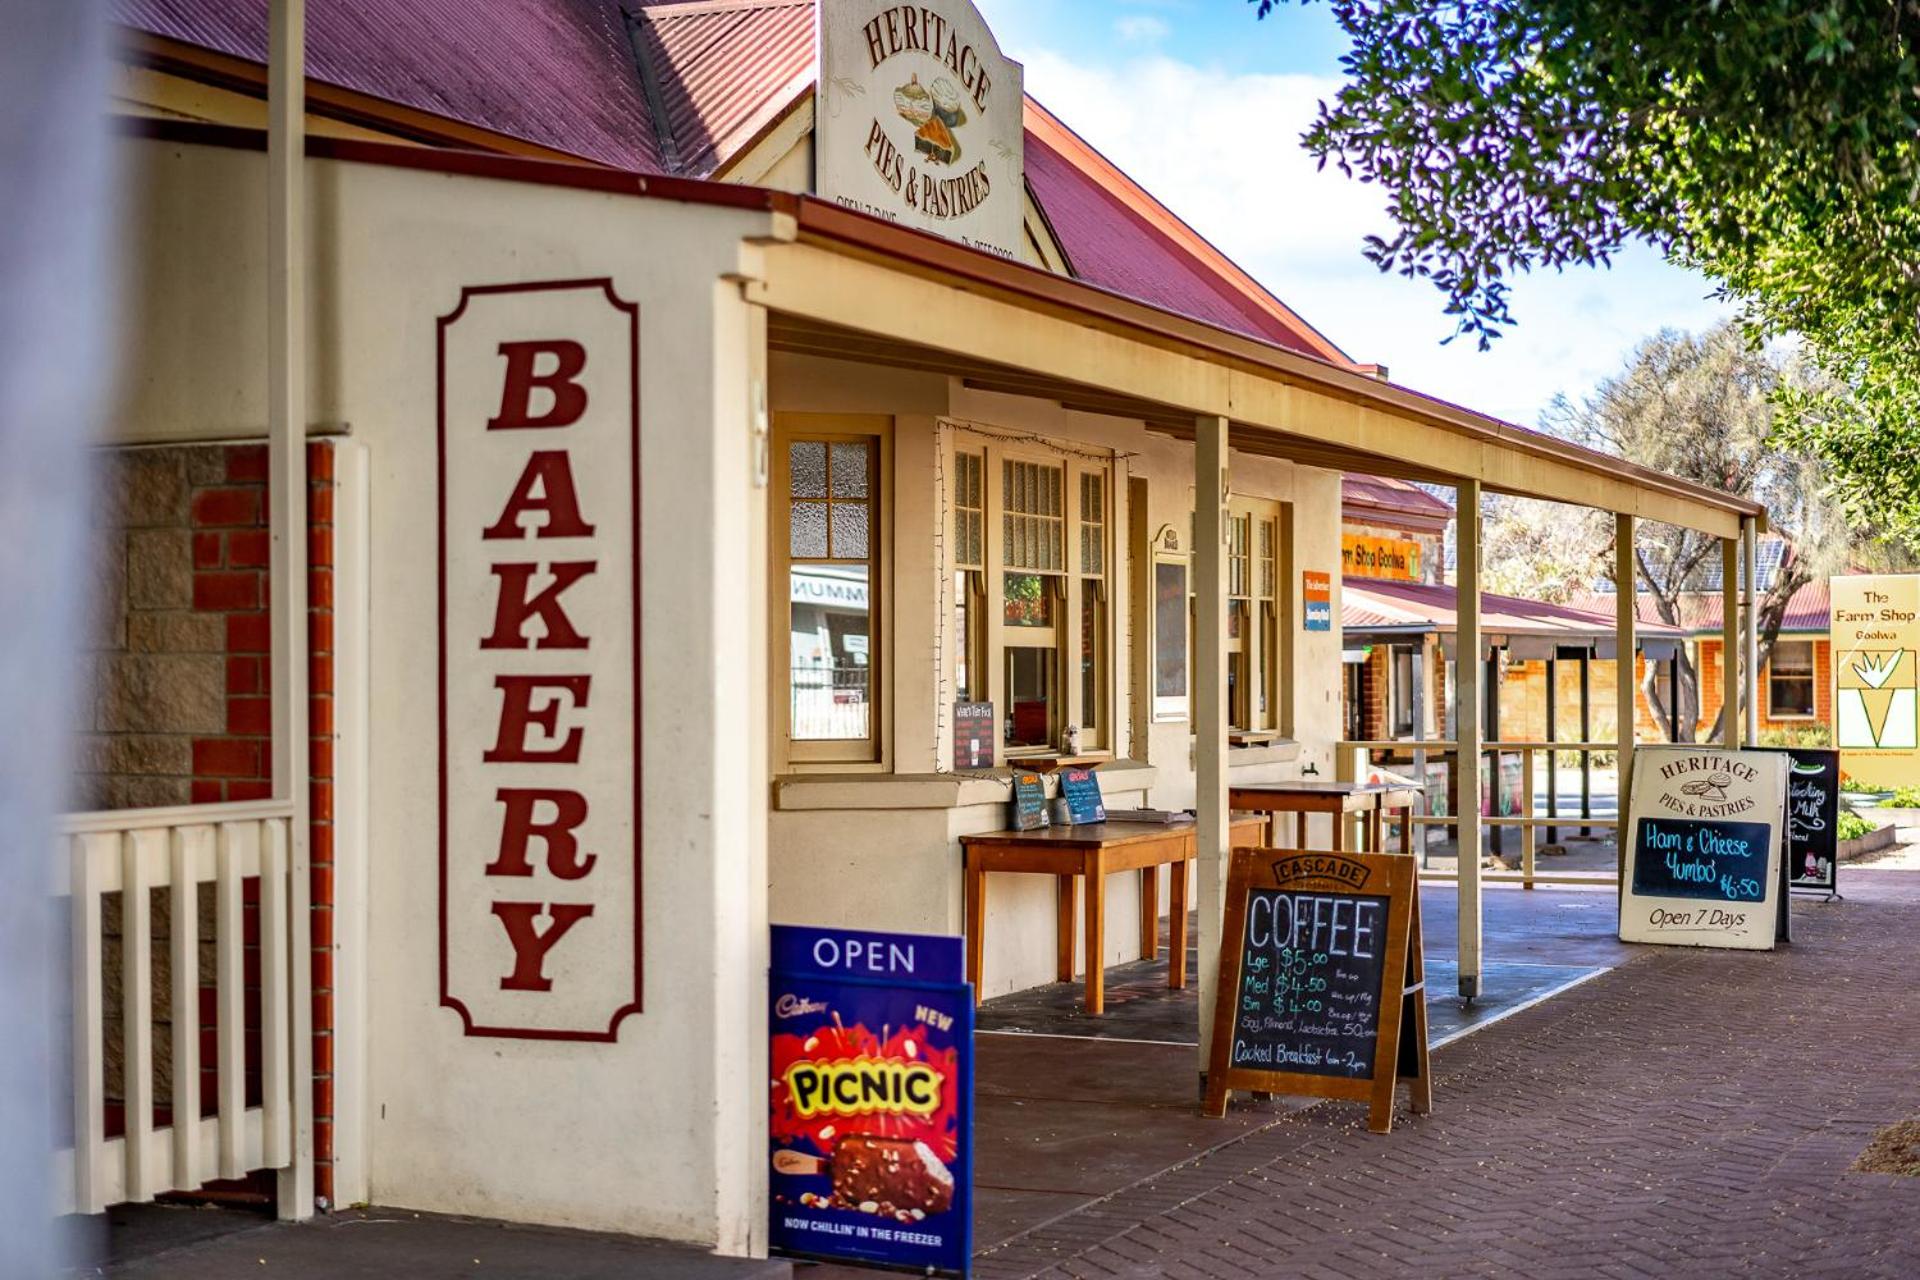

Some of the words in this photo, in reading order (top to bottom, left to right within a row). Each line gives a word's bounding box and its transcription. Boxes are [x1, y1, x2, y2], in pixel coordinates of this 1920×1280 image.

[862, 5, 992, 115] HERITAGE
[863, 116, 905, 195] PIES
[906, 166, 919, 208] &
[921, 160, 991, 220] PASTRIES
[1356, 544, 1376, 570] Shop
[1378, 546, 1405, 569] Goolwa
[1863, 591, 1889, 604] The
[1835, 609, 1875, 622] Farm
[1880, 608, 1916, 624] Shop
[1855, 630, 1897, 640] Goolwa
[480, 339, 598, 991] BAKERY
[1659, 755, 1759, 783] HERITAGE
[1658, 791, 1684, 813] PIES
[1686, 803, 1697, 816] &
[1699, 795, 1756, 818] PASTRIES
[1646, 823, 1682, 850] Ham
[1699, 828, 1752, 857] Cheese
[1279, 858, 1362, 882] CASCADE
[1720, 874, 1760, 899] $6.50
[1250, 894, 1380, 959] COFFEE
[1649, 908, 1691, 929] Open
[1694, 909, 1707, 925] 7
[1708, 909, 1745, 929] Days
[813, 938, 915, 974] OPEN
[1247, 950, 1270, 973] Lge
[1245, 976, 1270, 994] Med
[1243, 995, 1260, 1011] Sm
[914, 1004, 954, 1032] NEW
[1235, 1039, 1272, 1063] Cooked
[1277, 1043, 1323, 1065] Breakfast
[793, 1068, 932, 1110] PICNIC
[784, 1217, 810, 1231] NOW
[810, 1221, 856, 1236] CHILLIN'
[856, 1226, 869, 1239] IN
[870, 1228, 892, 1241] THE
[893, 1230, 943, 1247] FREEZER
